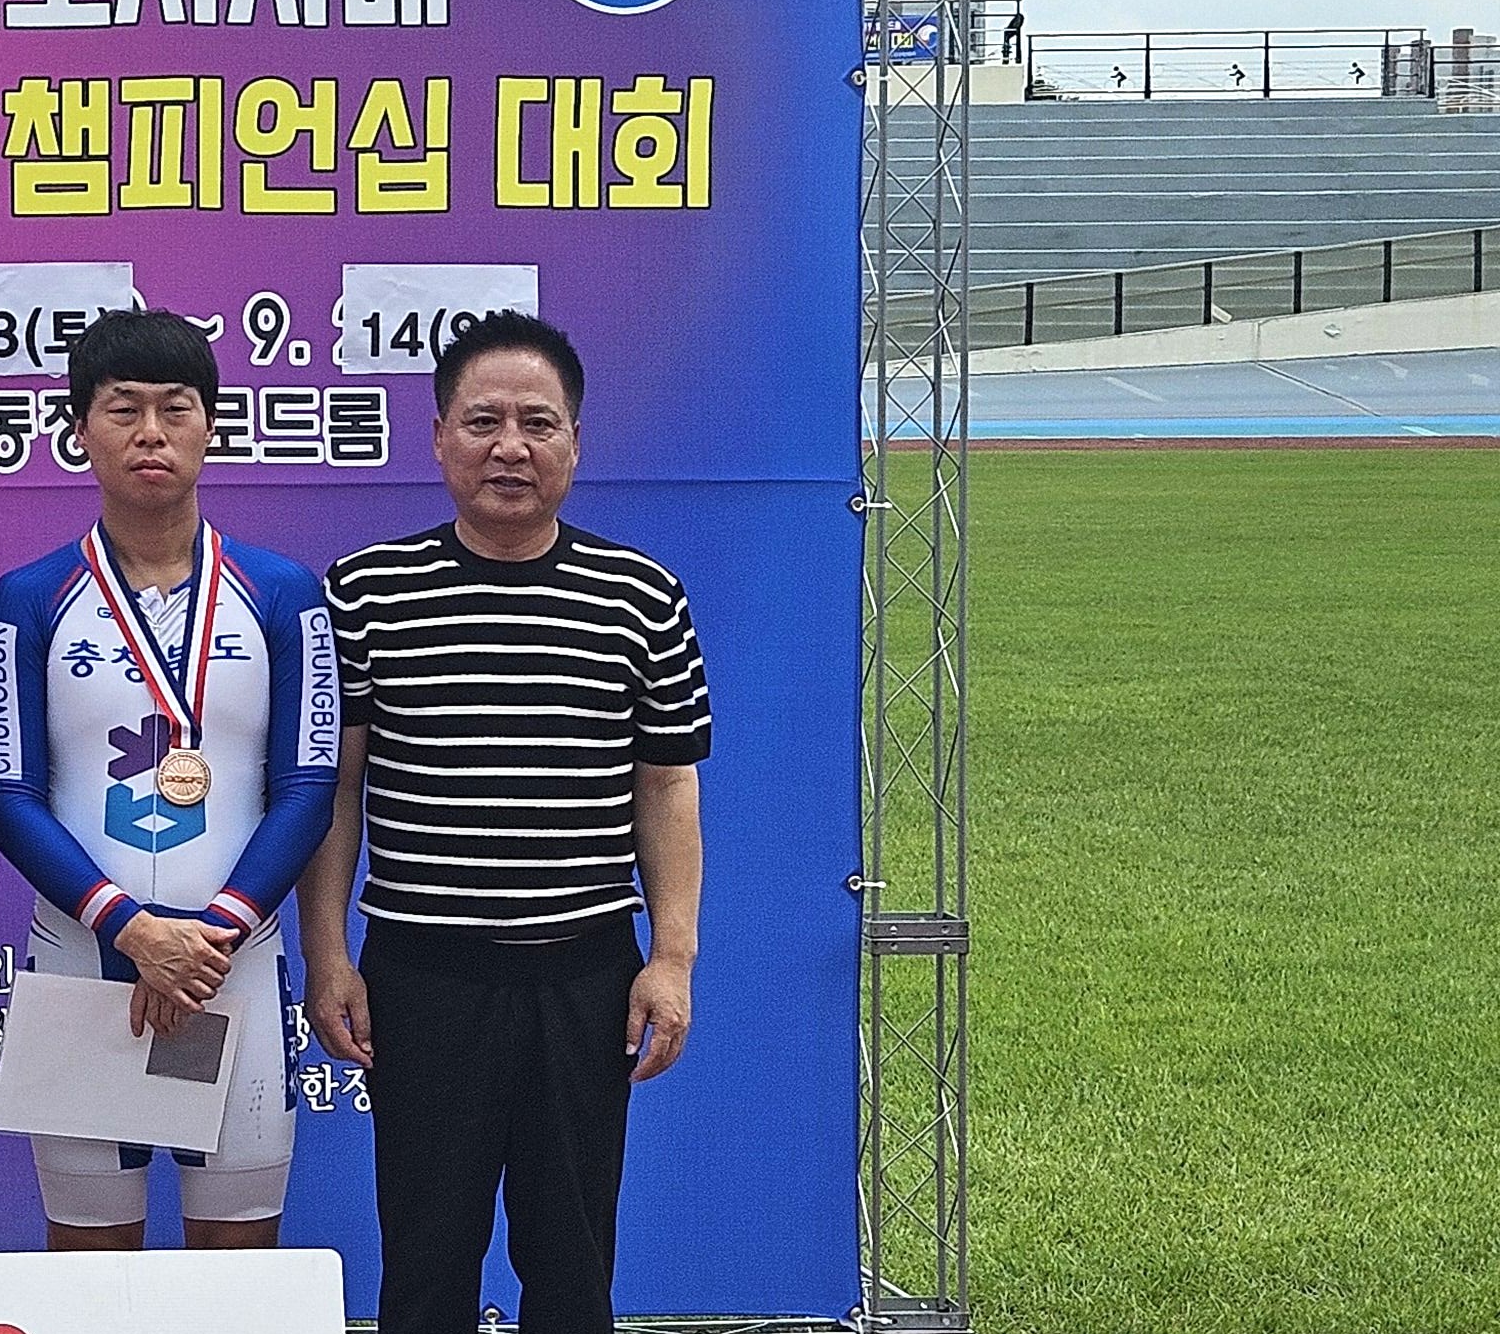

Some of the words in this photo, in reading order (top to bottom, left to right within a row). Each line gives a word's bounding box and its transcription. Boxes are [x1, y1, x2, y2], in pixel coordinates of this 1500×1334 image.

[2, 75, 452, 217] 챔피언십
[493, 73, 716, 213] 대회
[307, 612, 336, 764] CHUNGBUK
